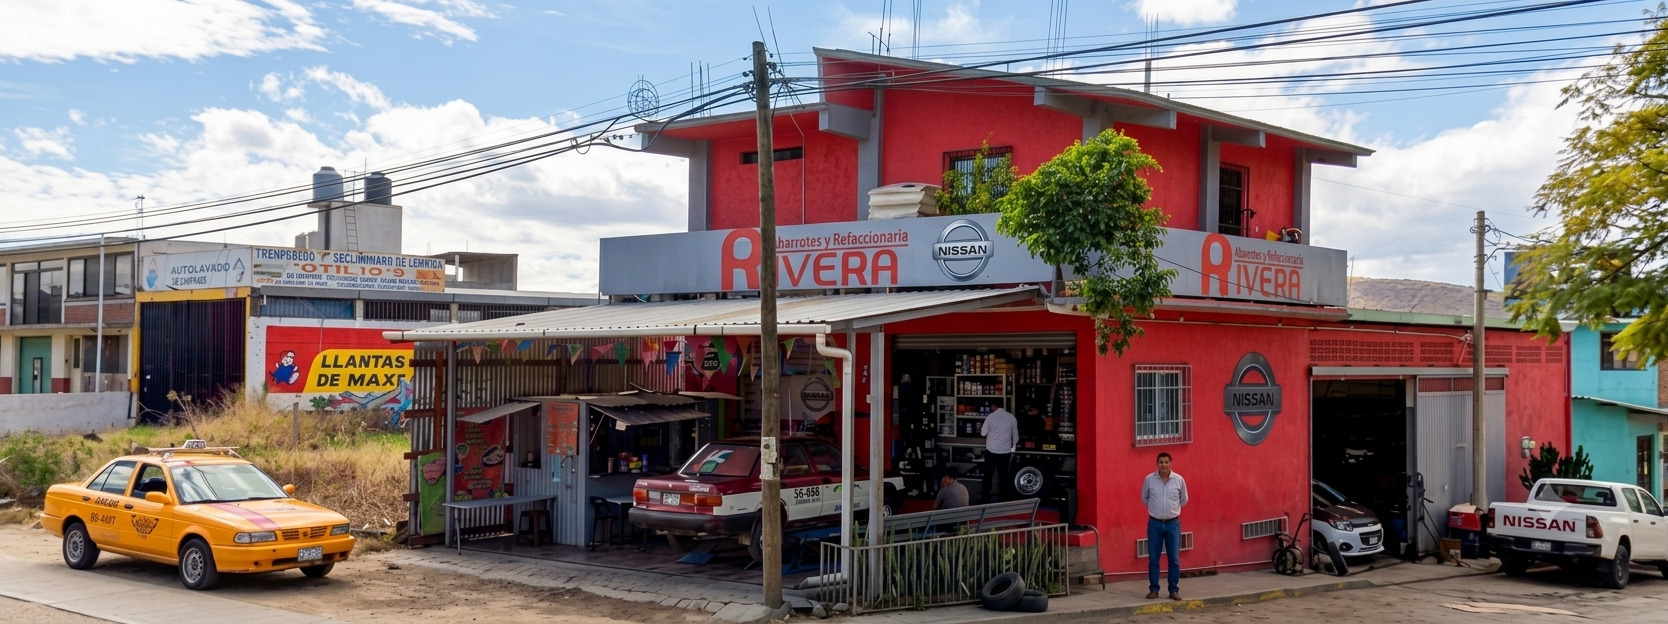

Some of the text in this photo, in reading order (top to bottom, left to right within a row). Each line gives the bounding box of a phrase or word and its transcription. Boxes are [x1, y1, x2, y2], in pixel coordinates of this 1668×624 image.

[825, 236, 831, 250] y
[833, 229, 909, 246] Refaccionaria
[938, 244, 987, 256] NISSAN
[171, 262, 231, 275] AUTOLAVADO
[1202, 232, 1301, 299] RIVERA
[321, 354, 406, 369] LLANTAS
[316, 374, 340, 387] DE
[1232, 392, 1275, 407] NISSAN
[1503, 515, 1576, 532] NISSAN
